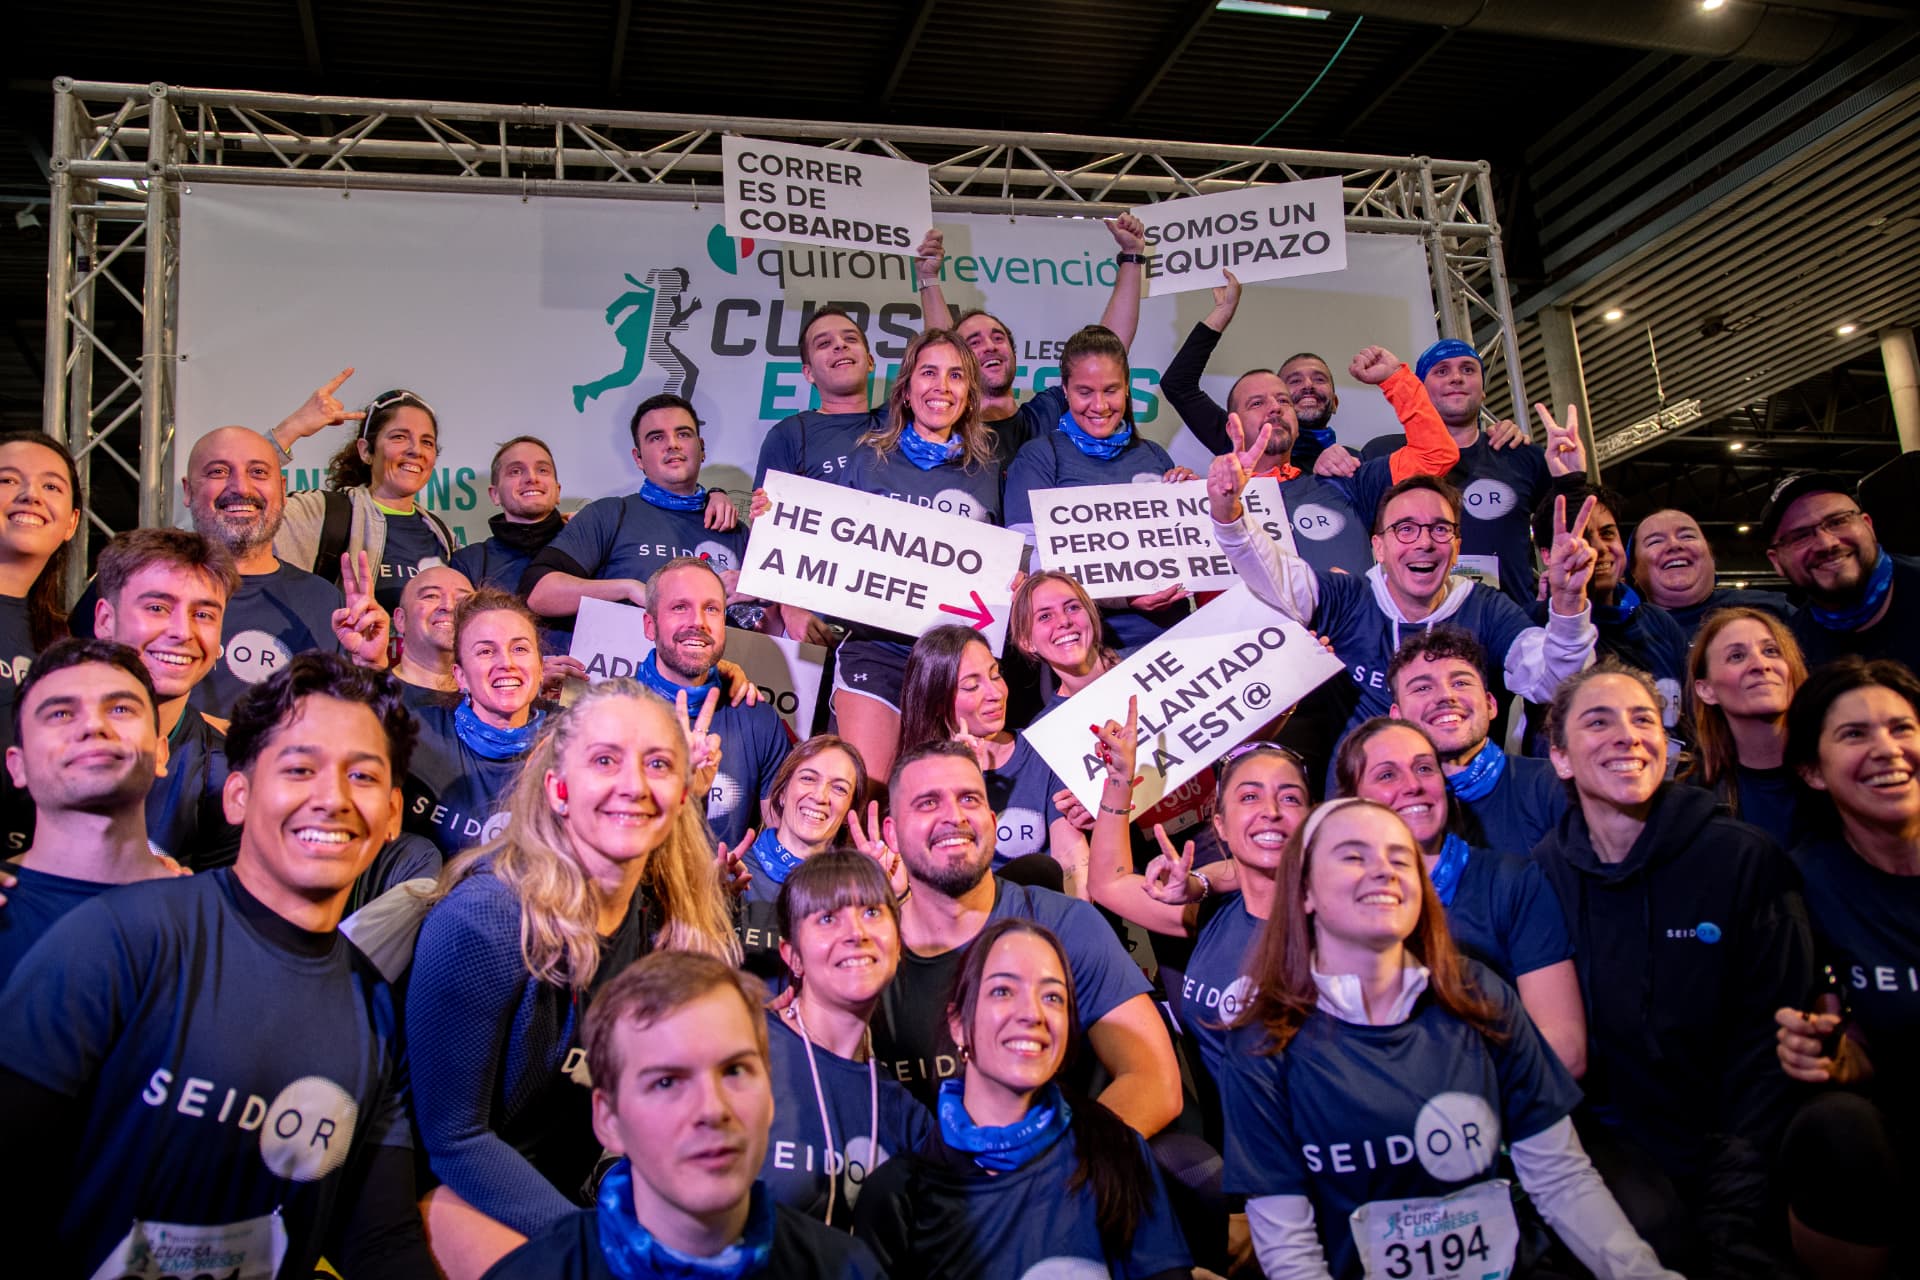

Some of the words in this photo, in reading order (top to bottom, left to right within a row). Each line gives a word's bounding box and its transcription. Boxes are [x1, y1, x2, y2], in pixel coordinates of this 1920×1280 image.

[737, 151, 863, 187] CORRER
[739, 180, 776, 203] ES
[786, 184, 826, 210] DE
[739, 208, 911, 248] COBARDES
[1144, 210, 1258, 246] SOMOS
[1269, 202, 1316, 227] UN
[1144, 231, 1331, 279] EQUIPAZO
[1050, 499, 1169, 525] CORRER
[639, 544, 729, 566] SEIDR
[773, 502, 822, 535] HE
[830, 517, 983, 575] GANADO
[1050, 530, 1129, 554] PERO
[1137, 522, 1210, 548] REÍR,
[759, 548, 785, 575] A
[796, 555, 838, 587] MI
[845, 569, 928, 610] JEFE
[1059, 558, 1180, 586] HEMOS
[1132, 650, 1184, 693] HE
[1083, 626, 1286, 781] AELANTADO
[1152, 748, 1184, 778] A
[1178, 682, 1271, 754] EST@
[142, 1067, 336, 1150] SEIDOR
[1302, 1122, 1482, 1174] SEIDOR
[1385, 1224, 1490, 1280] 3194
